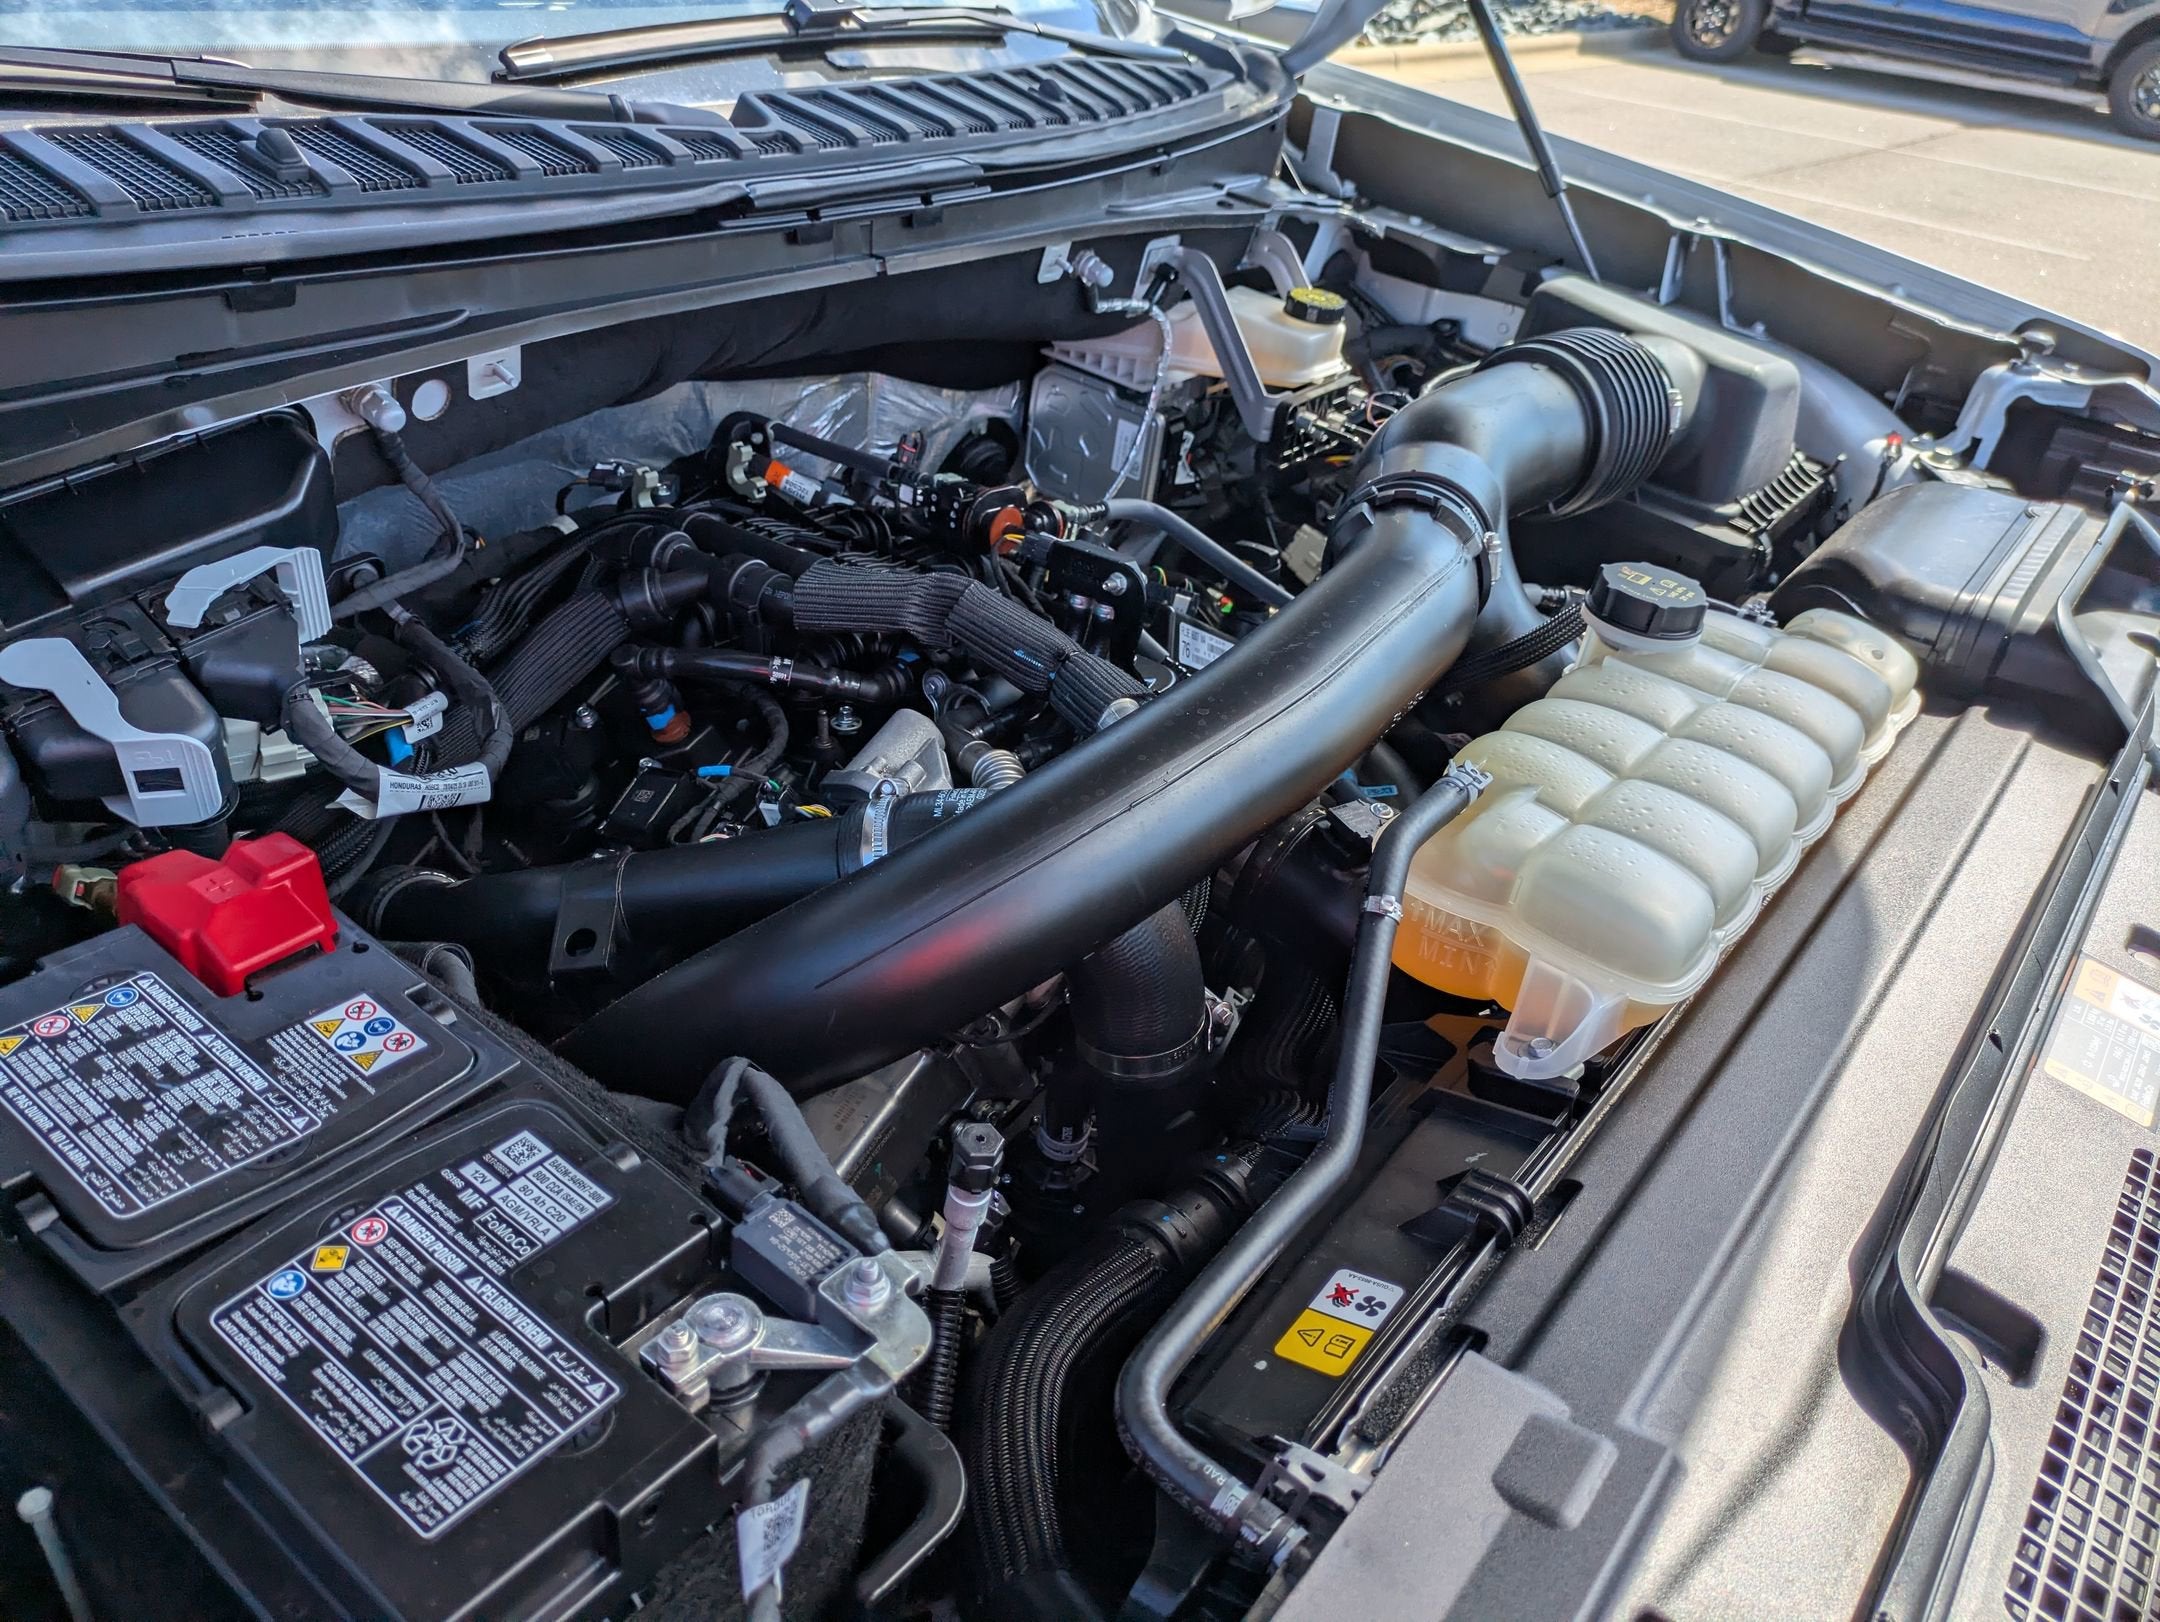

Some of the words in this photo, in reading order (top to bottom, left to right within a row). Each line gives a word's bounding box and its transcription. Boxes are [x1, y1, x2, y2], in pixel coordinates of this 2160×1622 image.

[1424, 907, 1486, 947] MAX
[1418, 935, 1480, 975] MIN
[143, 983, 203, 1031] DANGER/POISON
[206, 1040, 269, 1091] PELIGRO/VENENO
[2, 1086, 23, 1098] NE
[10, 1093, 33, 1109] PAS
[22, 1105, 58, 1132] OUVRIR.
[48, 1129, 69, 1143] NO
[57, 1138, 78, 1151] LA
[66, 1147, 97, 1170] ABRA.
[469, 1168, 491, 1186] 12V
[531, 1170, 550, 1184] 800
[544, 1180, 564, 1196] CCA
[559, 1191, 589, 1215] (SAE/EN)
[456, 1187, 489, 1213] MF
[497, 1191, 552, 1238] AGM/VRLA
[516, 1183, 534, 1197] 80
[529, 1193, 549, 1208] Ah
[543, 1204, 567, 1224] C20
[394, 1212, 468, 1274] DANGER/POISON
[479, 1210, 534, 1258] FoMoCo
[253, 1295, 310, 1348] NON-SPILLABLE
[476, 1283, 553, 1348] PELIGRO/VENENO
[321, 1361, 356, 1392] CONTRA
[349, 1387, 394, 1430] DERRAMES
[426, 1432, 446, 1450] Pb
[1203, 1464, 1226, 1486] RAD
